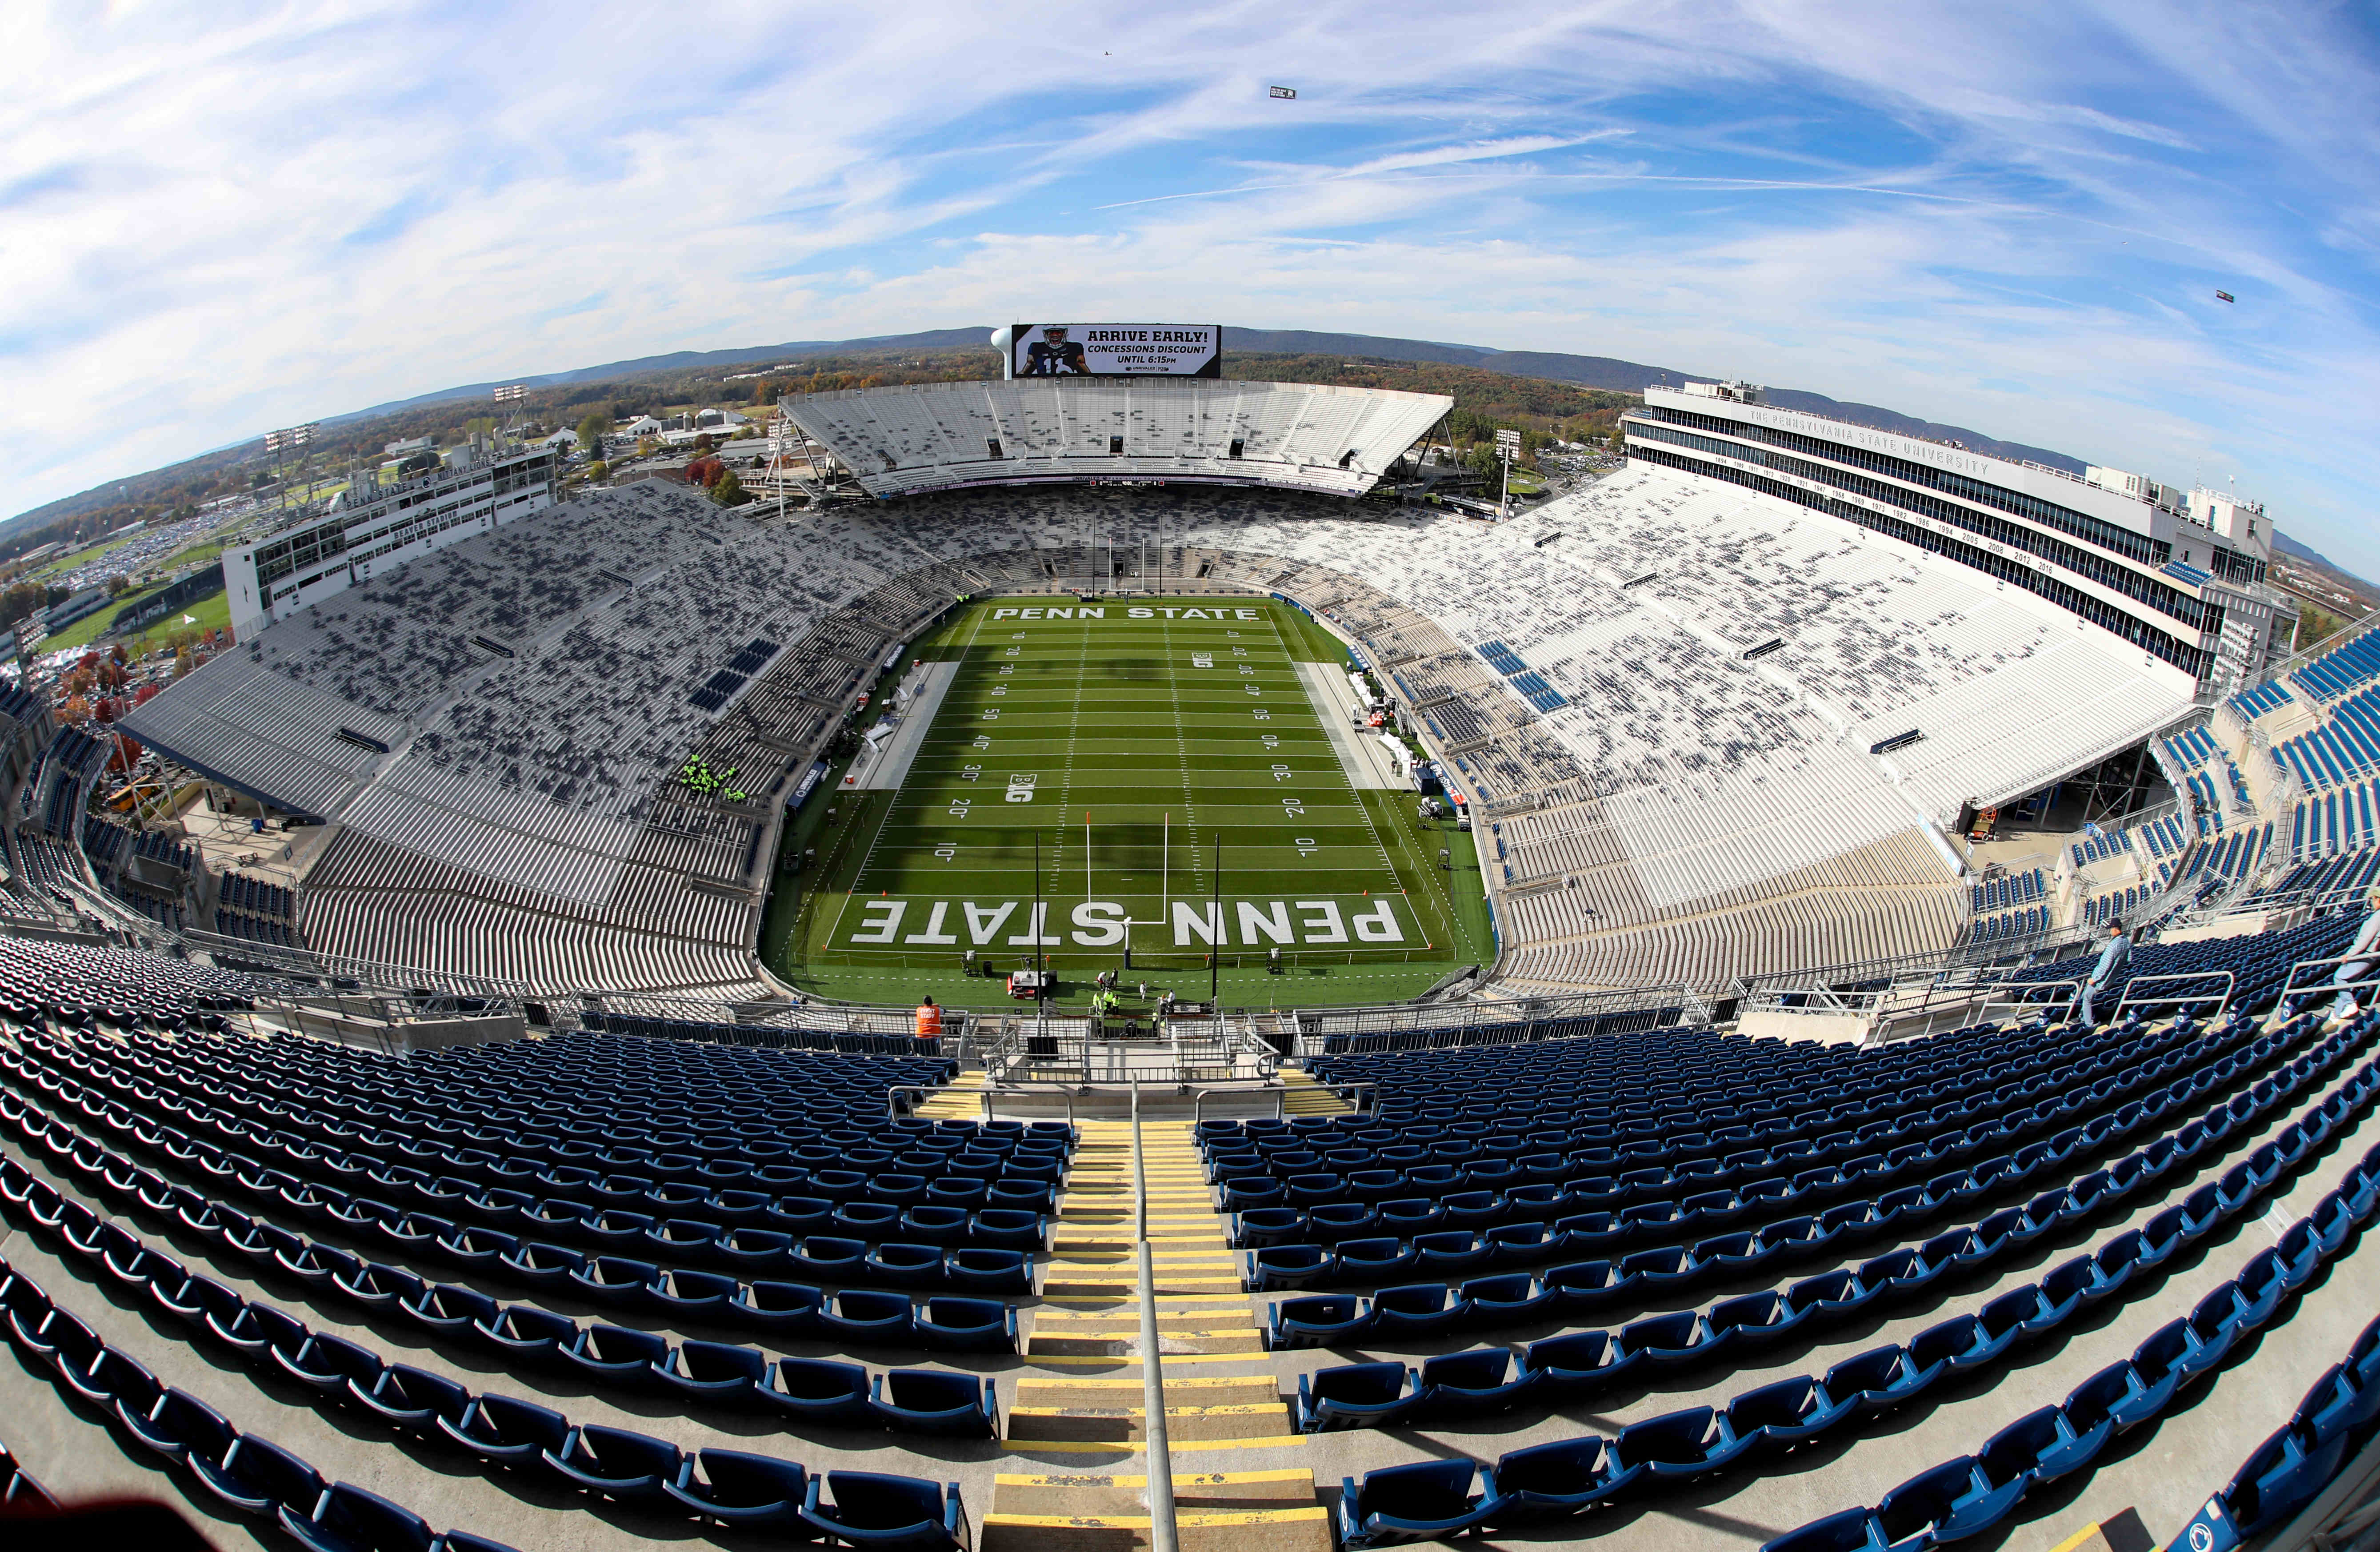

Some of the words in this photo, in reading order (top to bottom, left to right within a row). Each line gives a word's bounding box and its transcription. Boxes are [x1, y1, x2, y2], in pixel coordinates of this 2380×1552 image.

[1088, 331, 1147, 341] ARRIVE
[1152, 331, 1208, 342] EARLY!
[1751, 411, 1768, 423] THE
[1772, 415, 1852, 441] PENNSYLVANIA
[1859, 432, 1896, 451] STATE
[1904, 443, 1988, 475] UNIVERSITY
[347, 495, 372, 510] PENN
[379, 483, 407, 499] STATE
[438, 466, 467, 480] NITTANY
[470, 459, 489, 471] LIONS
[394, 523, 423, 539] BEAVER
[427, 511, 457, 527] STADIUM
[1833, 490, 1844, 499] 1968
[1852, 496, 1864, 505] 1969
[1872, 503, 1885, 512] 1973
[1893, 510, 1907, 519] 1982
[1916, 517, 1929, 527] 1986
[1939, 525, 1953, 535] 1994
[1963, 533, 1978, 544] 2005
[1988, 543, 2004, 554] 2008
[2014, 552, 2030, 564] 2012
[2039, 562, 2052, 574] 2016
[993, 608, 1104, 619] PENN
[1128, 608, 1260, 620] STATE
[999, 665, 1014, 674] 30
[1239, 666, 1254, 674] 30
[991, 686, 1007, 695] 40
[1245, 686, 1261, 696] 40
[983, 709, 1000, 720] 50
[1252, 709, 1270, 720] 50
[973, 735, 991, 747] 40
[1261, 735, 1279, 746] 40
[962, 765, 982, 778] 30
[1271, 765, 1291, 778] 30
[799, 769, 817, 790] UNRIVALED
[949, 799, 971, 814] 20
[1282, 799, 1305, 814] 20
[934, 842, 957, 857] 10
[1295, 838, 1318, 851] 10
[849, 901, 1125, 946] STATE
[1171, 900, 1405, 946] PENN
